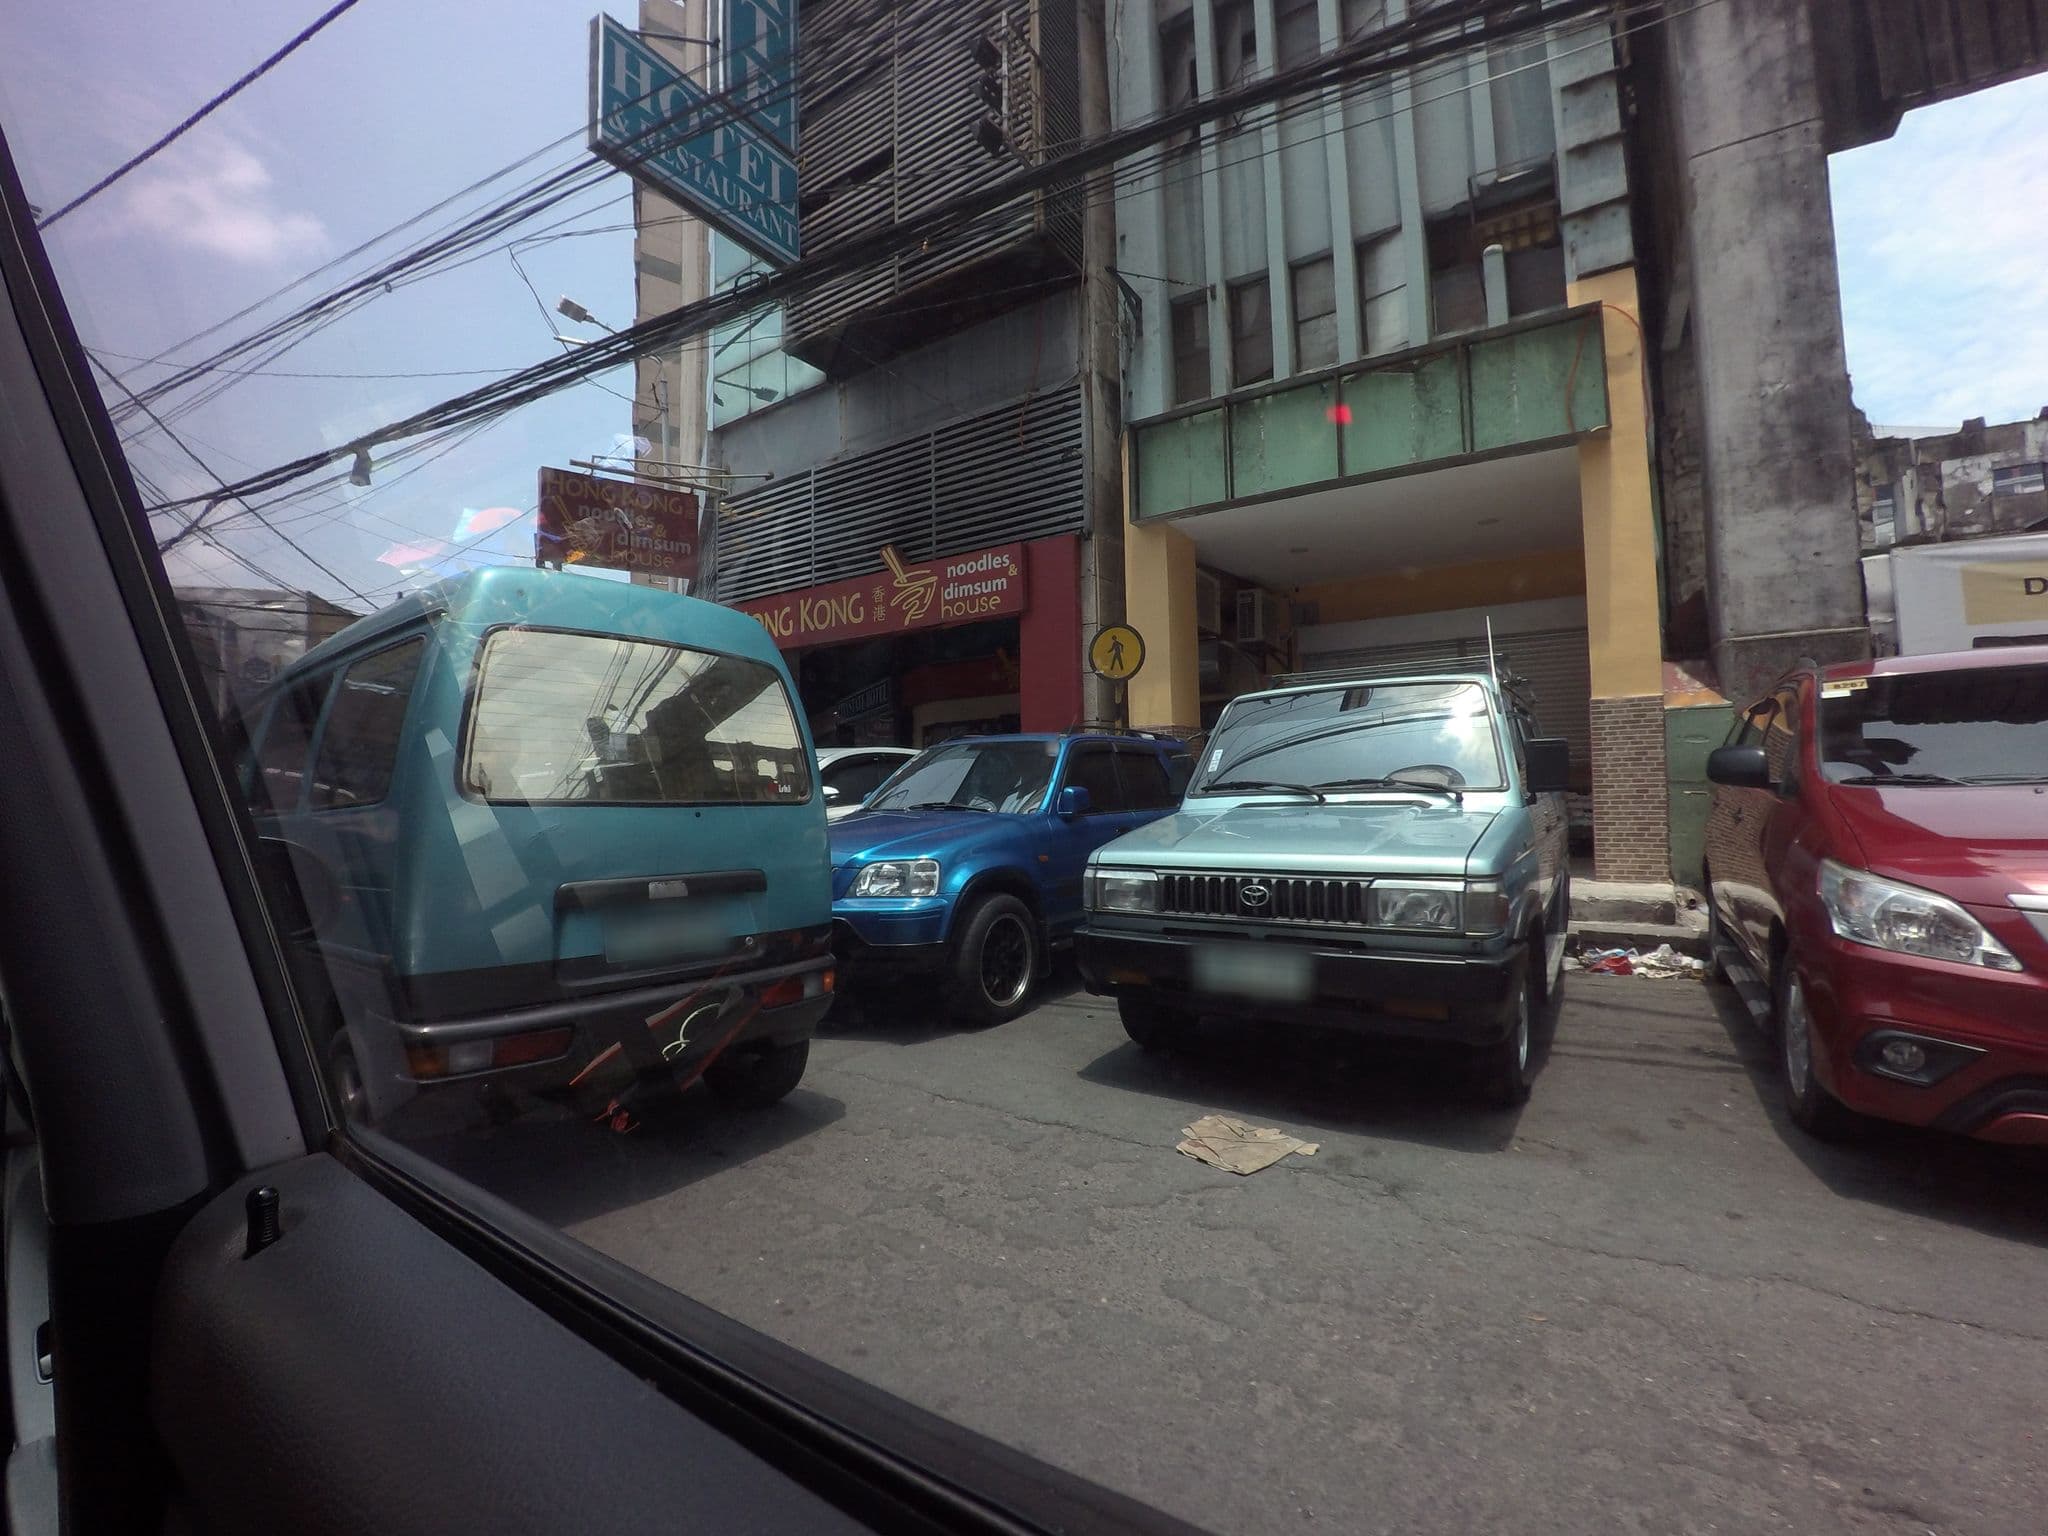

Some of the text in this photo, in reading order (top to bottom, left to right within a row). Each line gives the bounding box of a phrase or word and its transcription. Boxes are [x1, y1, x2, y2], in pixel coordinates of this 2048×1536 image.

[610, 36, 797, 214] HOTEL
[546, 473, 616, 505] HONG
[622, 487, 683, 514] KONG
[617, 530, 691, 554] dimsum
[947, 553, 1018, 579] noodles &
[872, 586, 885, 622] 香港
[941, 587, 1000, 619] house
[944, 576, 1007, 601] dimsum
[800, 592, 863, 633] KONG
